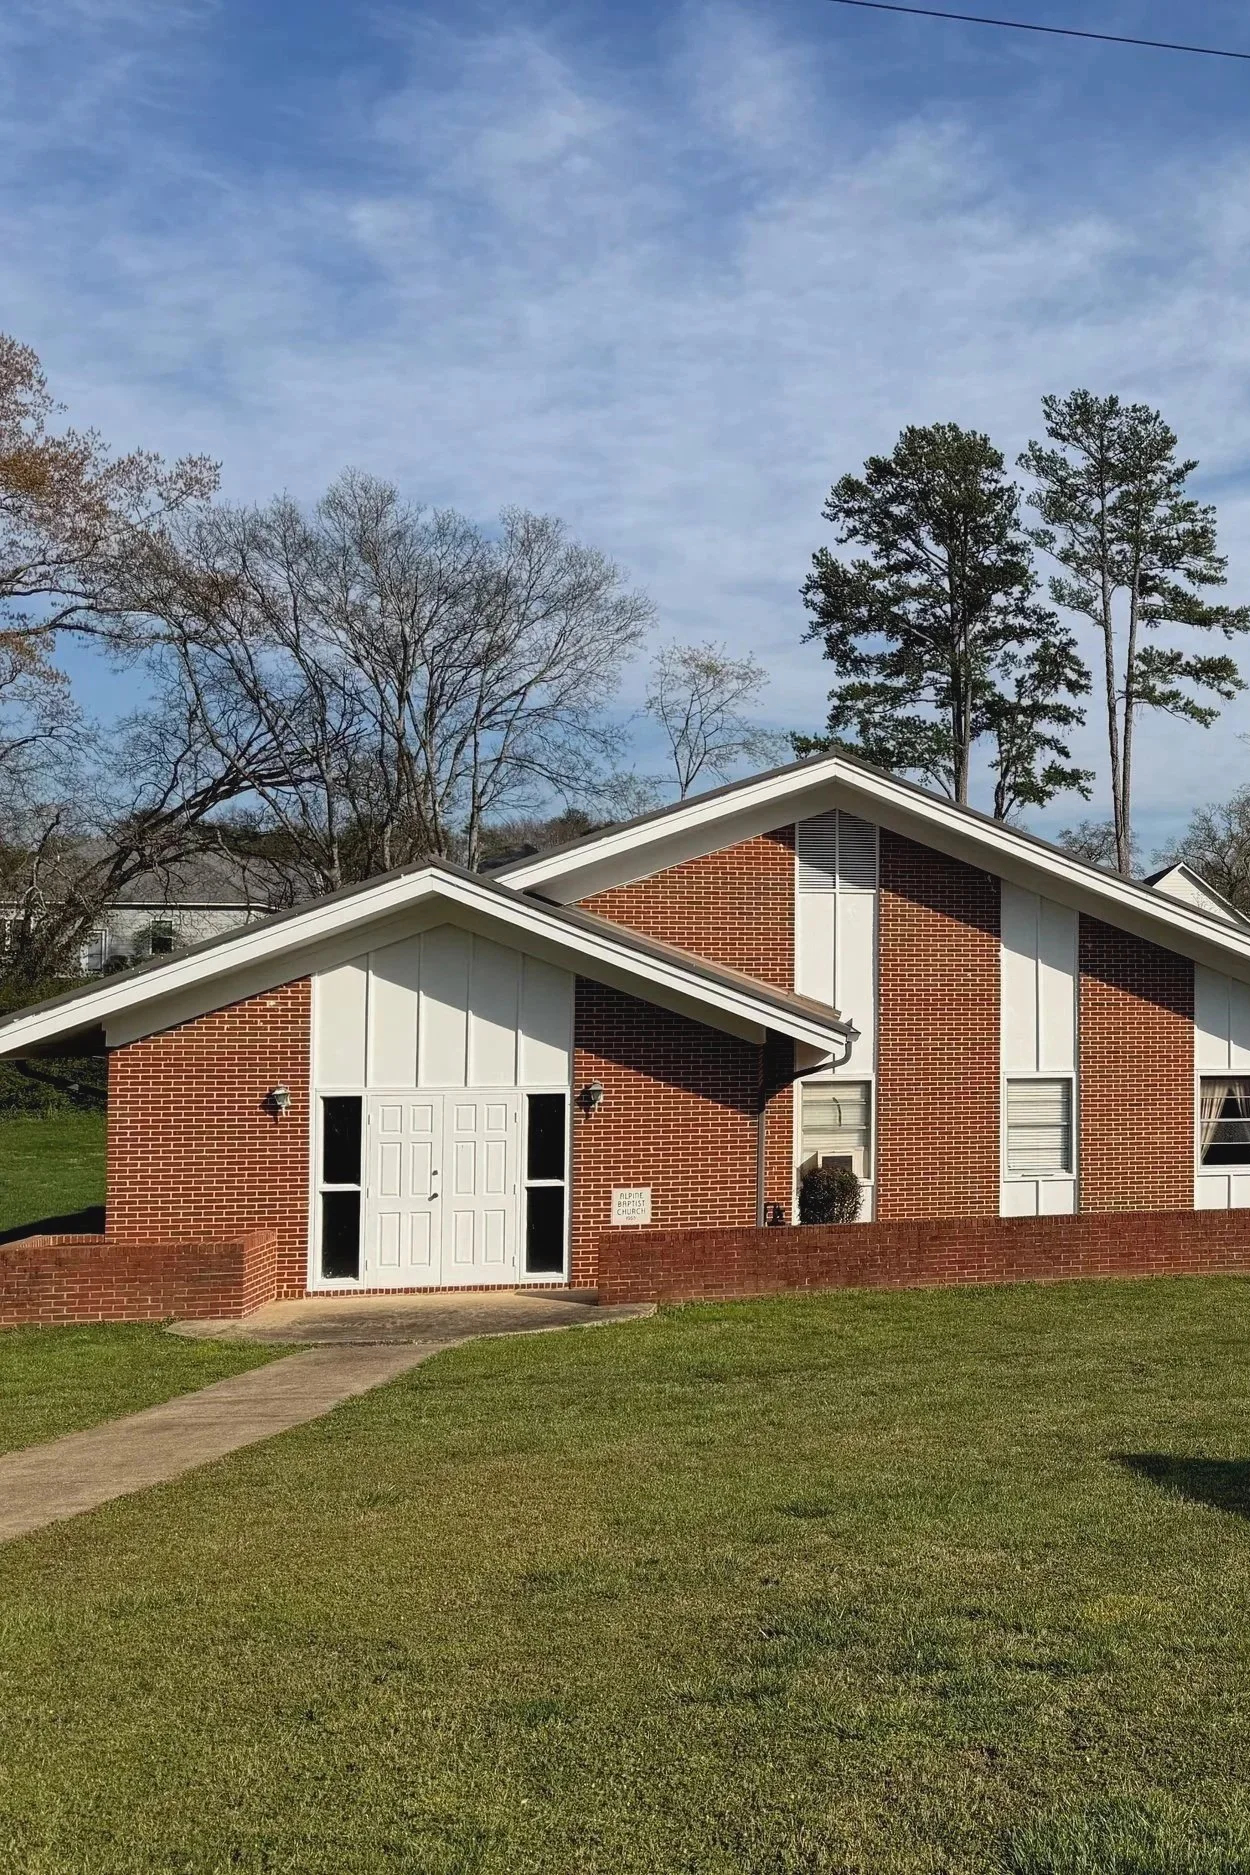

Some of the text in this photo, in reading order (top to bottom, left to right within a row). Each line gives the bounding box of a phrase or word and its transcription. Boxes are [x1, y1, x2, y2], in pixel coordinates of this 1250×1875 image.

[619, 1192, 644, 1200] ALPINE
[617, 1200, 645, 1208] BAPTIST
[616, 1207, 646, 1215] CHURCH
